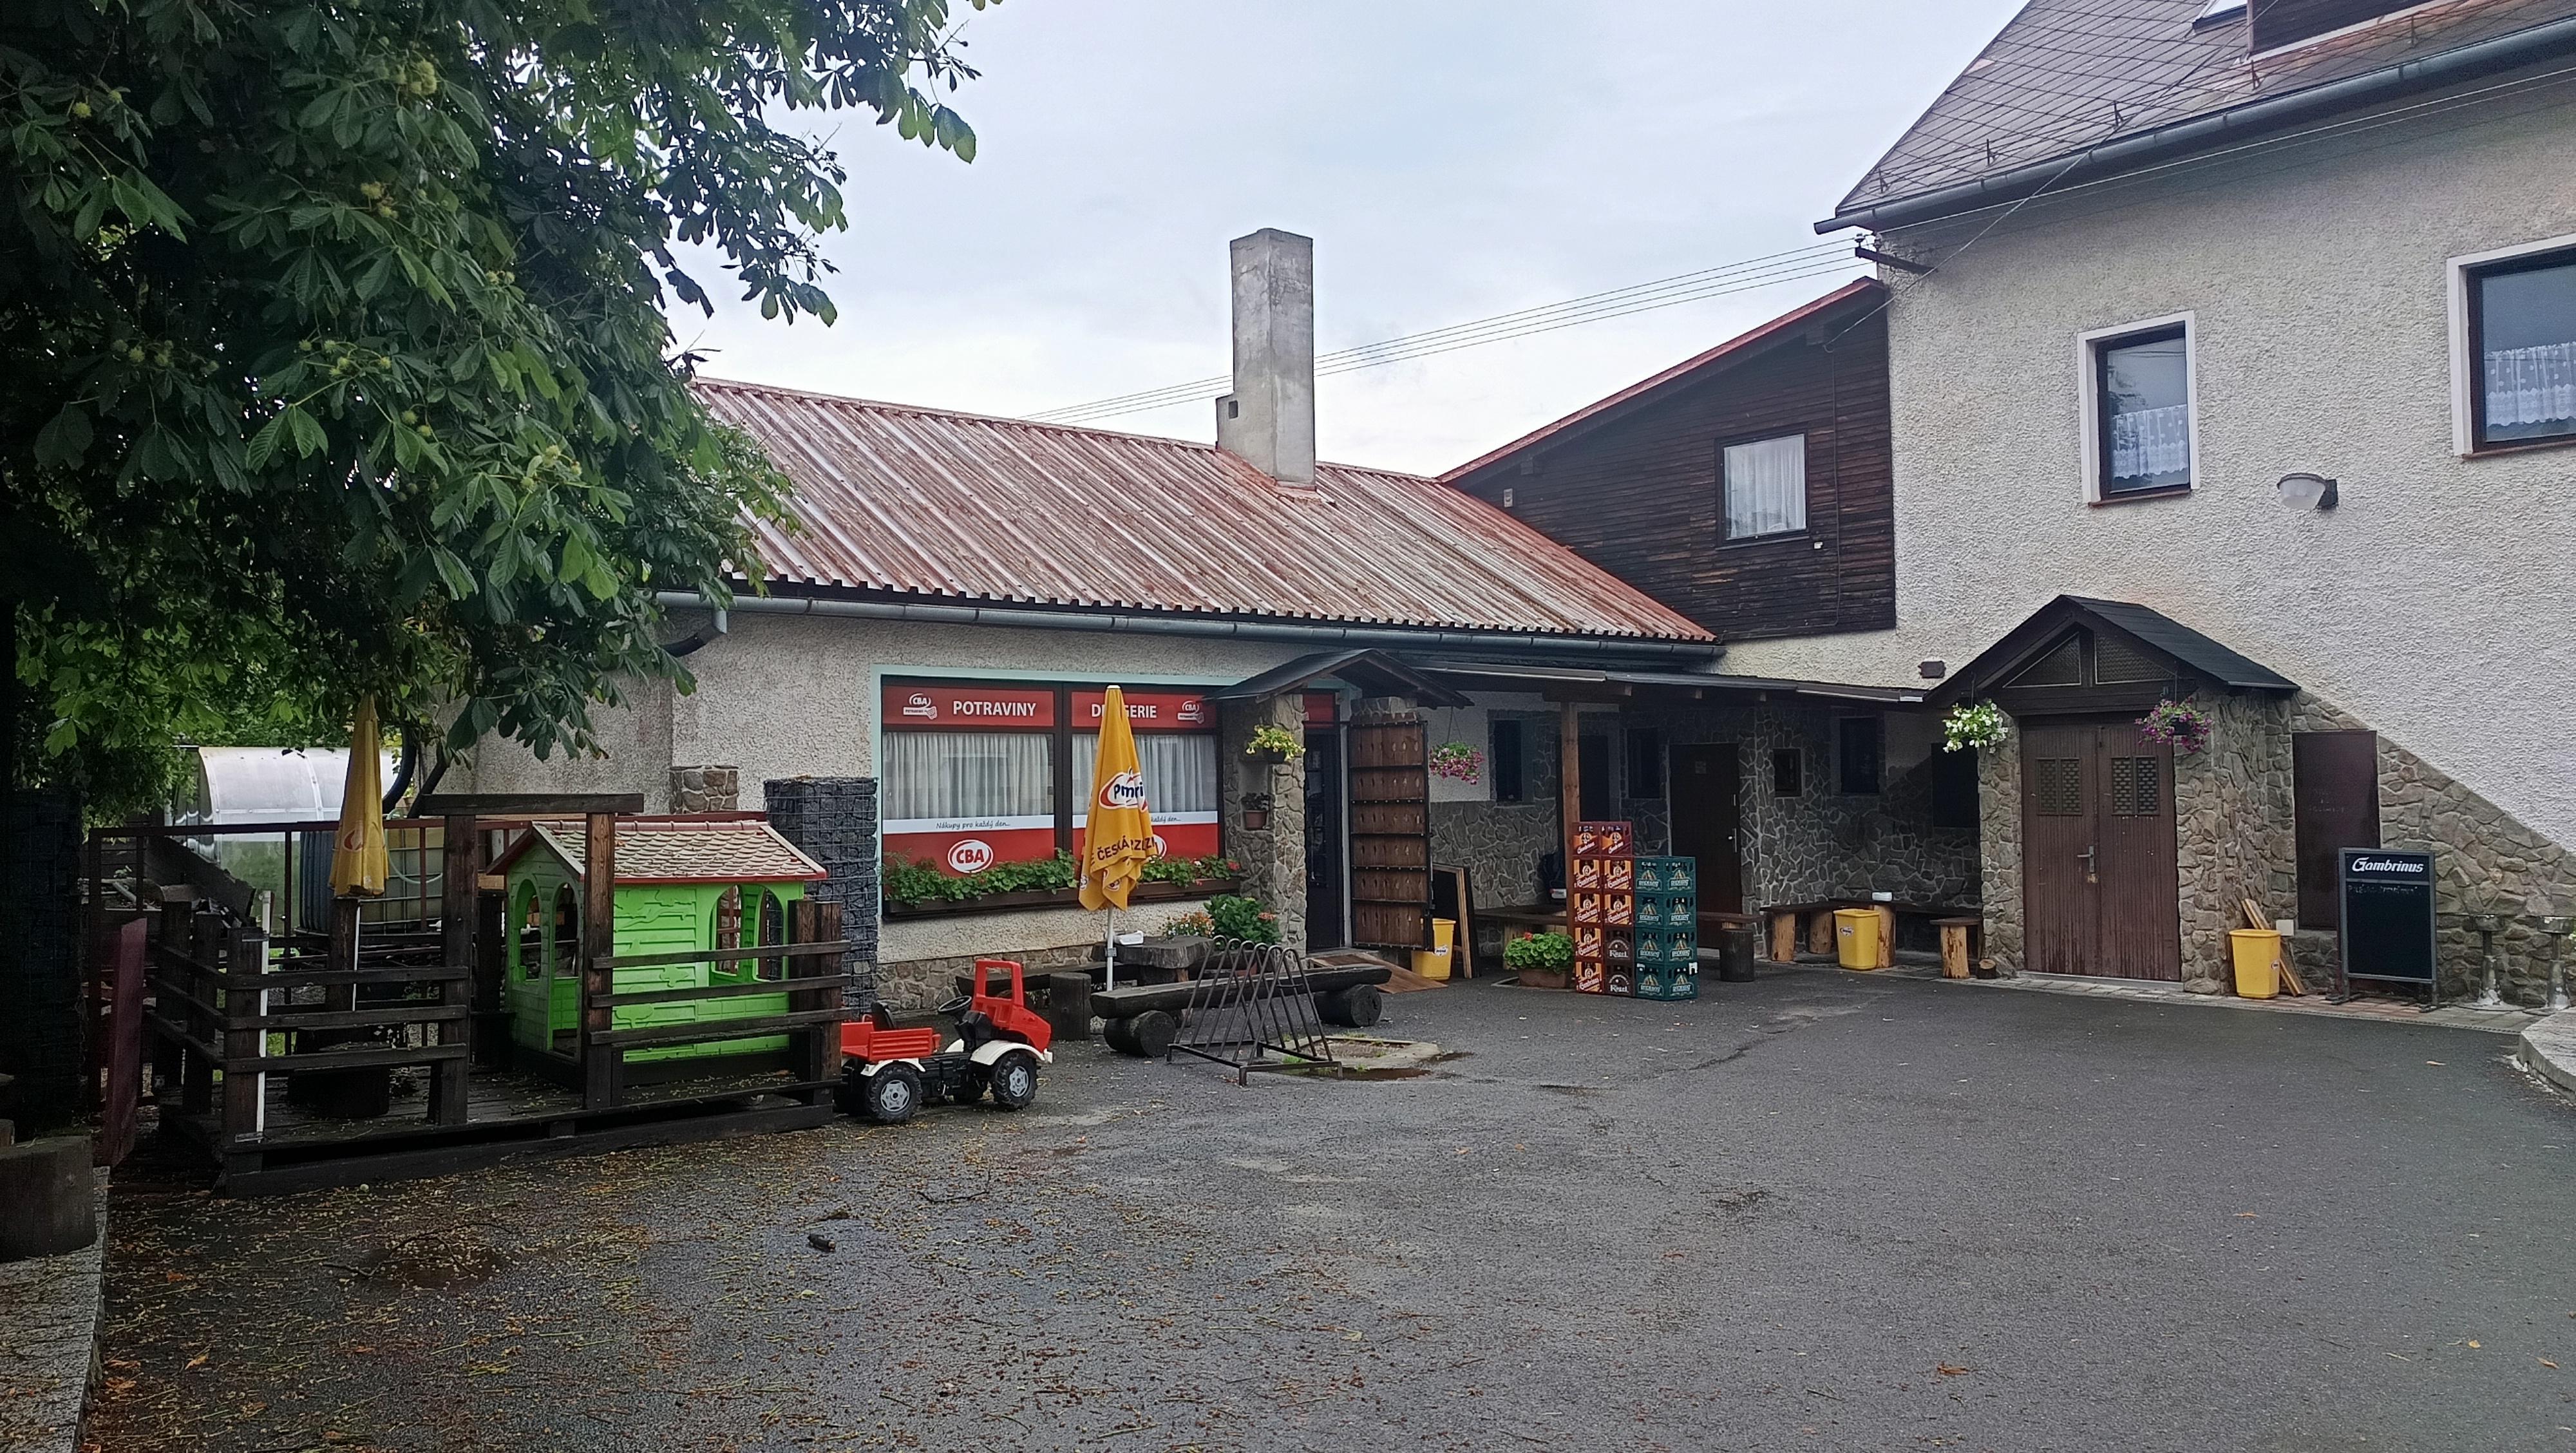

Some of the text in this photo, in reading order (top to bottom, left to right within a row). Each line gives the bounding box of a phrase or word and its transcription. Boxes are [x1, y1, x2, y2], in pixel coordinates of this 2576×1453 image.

[953, 700, 1037, 716] POTRAVINY
[956, 849, 985, 864] CBA
[2352, 857, 2424, 873] Gambrinus
